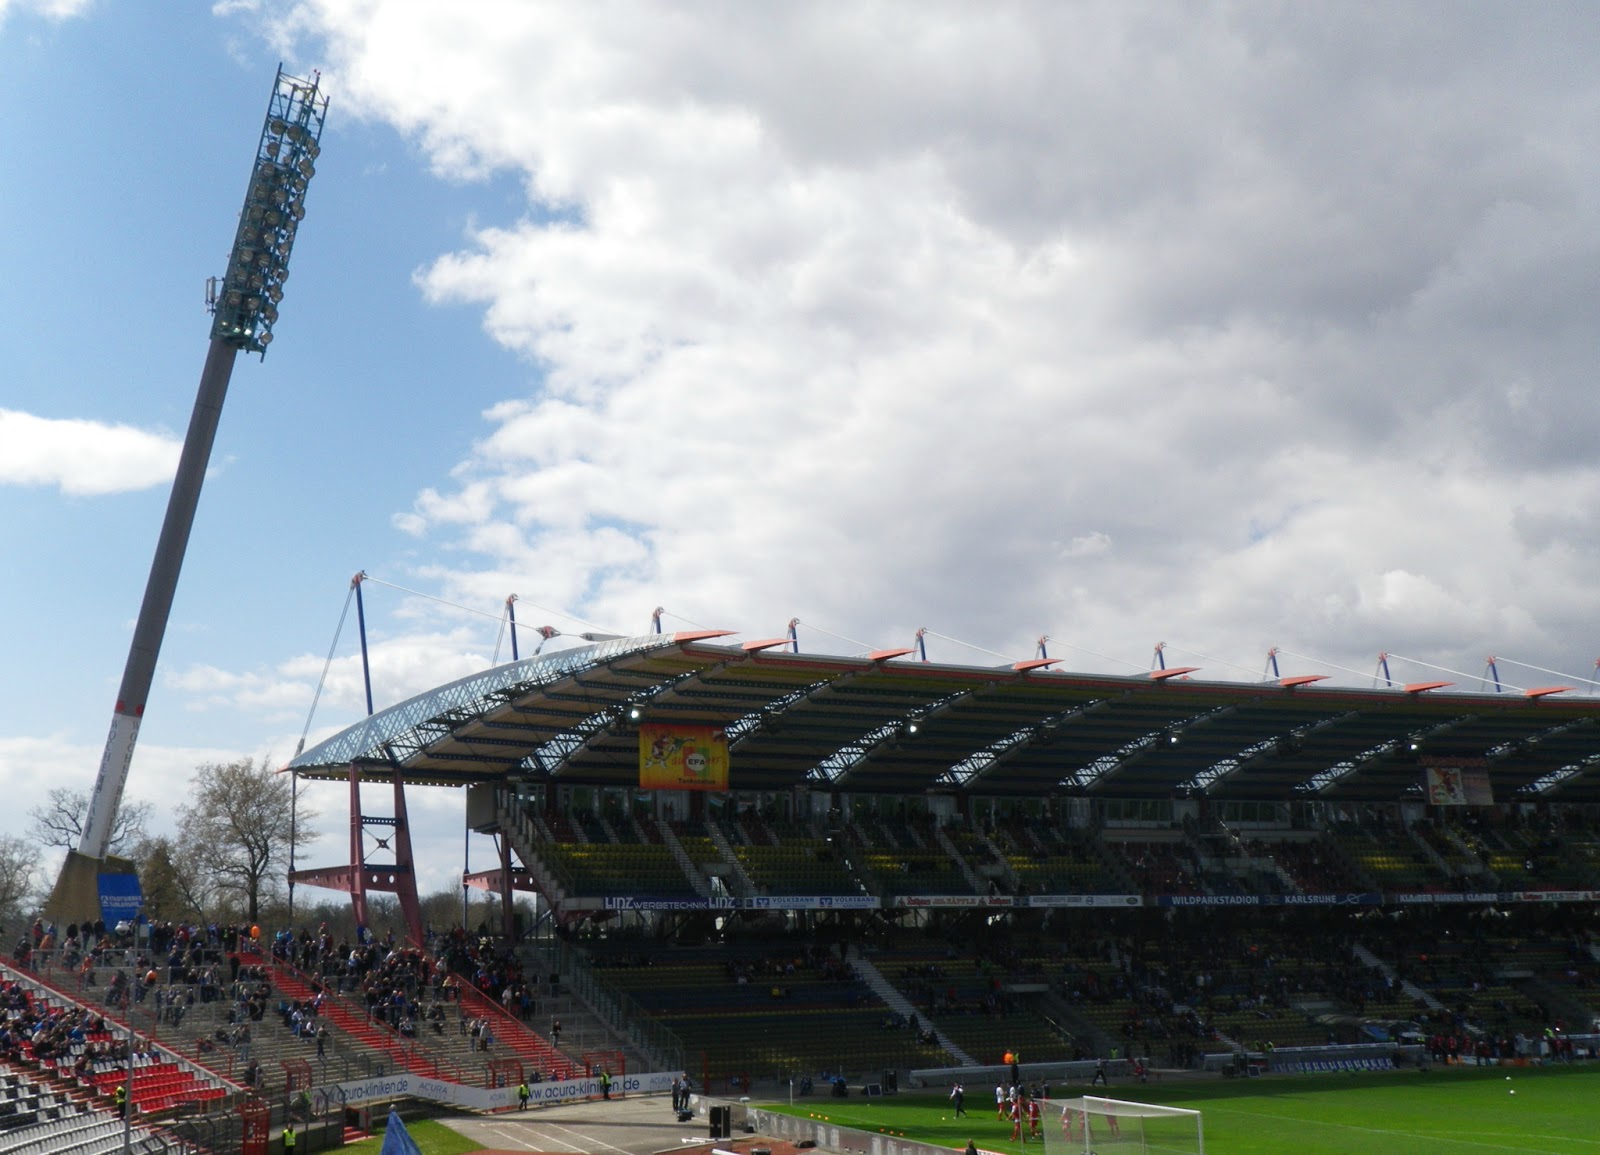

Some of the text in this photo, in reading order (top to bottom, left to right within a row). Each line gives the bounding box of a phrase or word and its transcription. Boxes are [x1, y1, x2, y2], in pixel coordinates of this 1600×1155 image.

[633, 901, 708, 909] WERBETECHNIK
[1171, 895, 1337, 905] WILDPARKSTADION KARLSRUHE
[419, 1082, 448, 1094] ACURA
